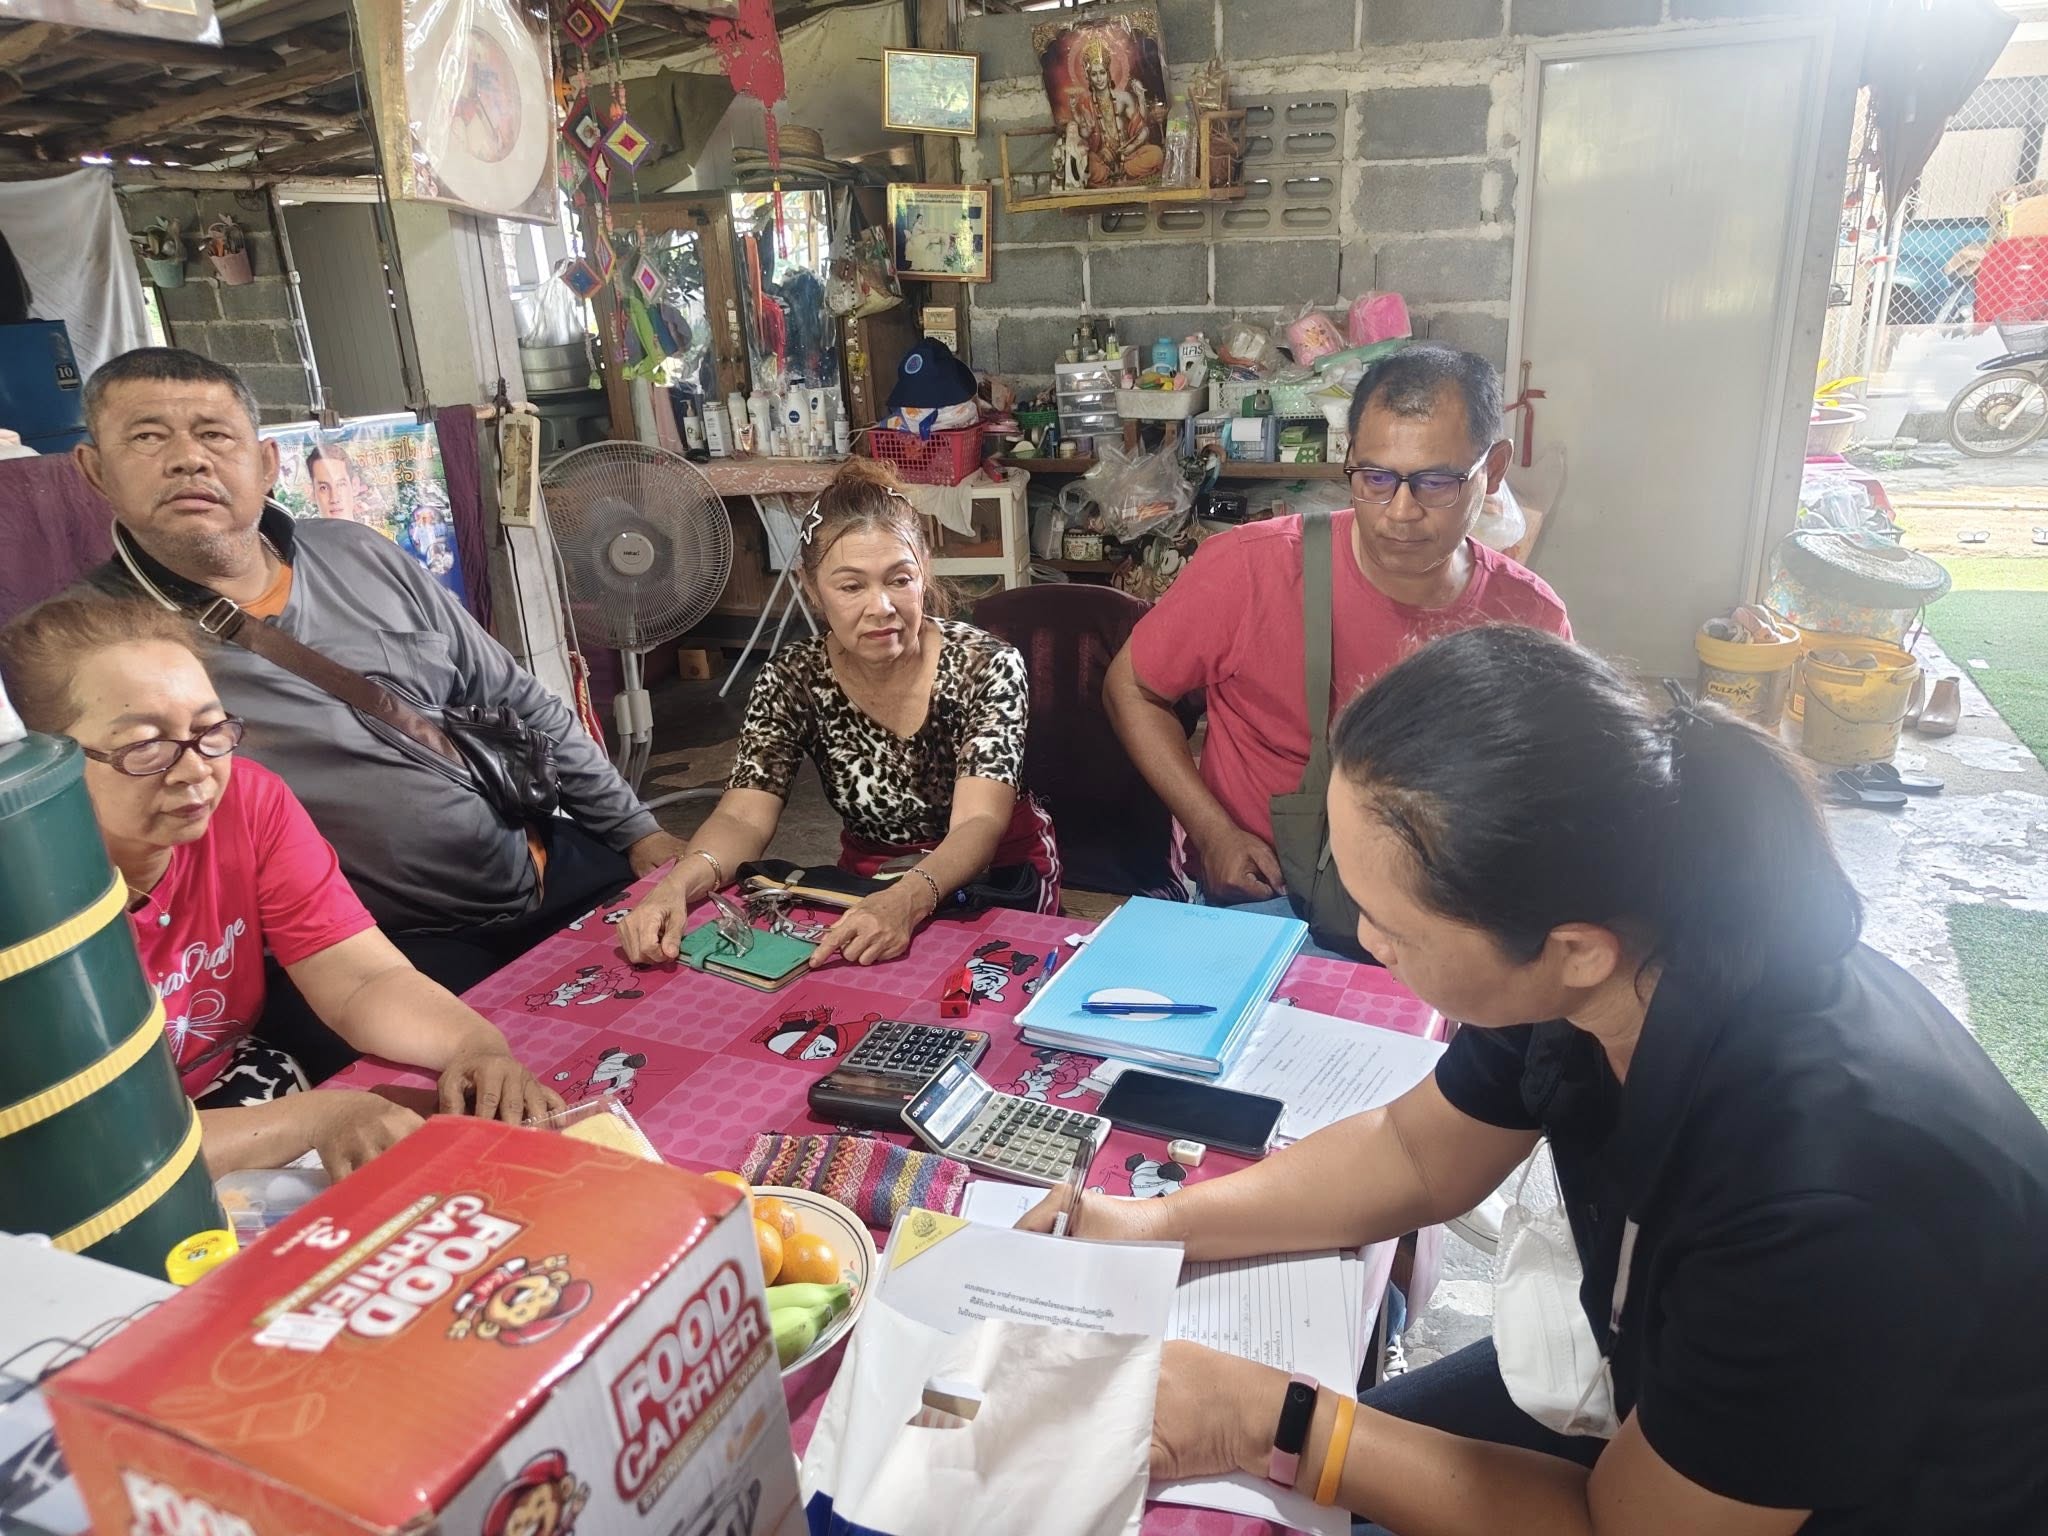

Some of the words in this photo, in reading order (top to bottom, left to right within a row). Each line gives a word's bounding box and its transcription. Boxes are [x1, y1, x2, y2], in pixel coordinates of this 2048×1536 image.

[309, 1195, 485, 1320] CARRIER
[349, 1212, 522, 1337] FOOD
[617, 1267, 741, 1437] FOOD
[620, 1306, 761, 1492] CARRIER
